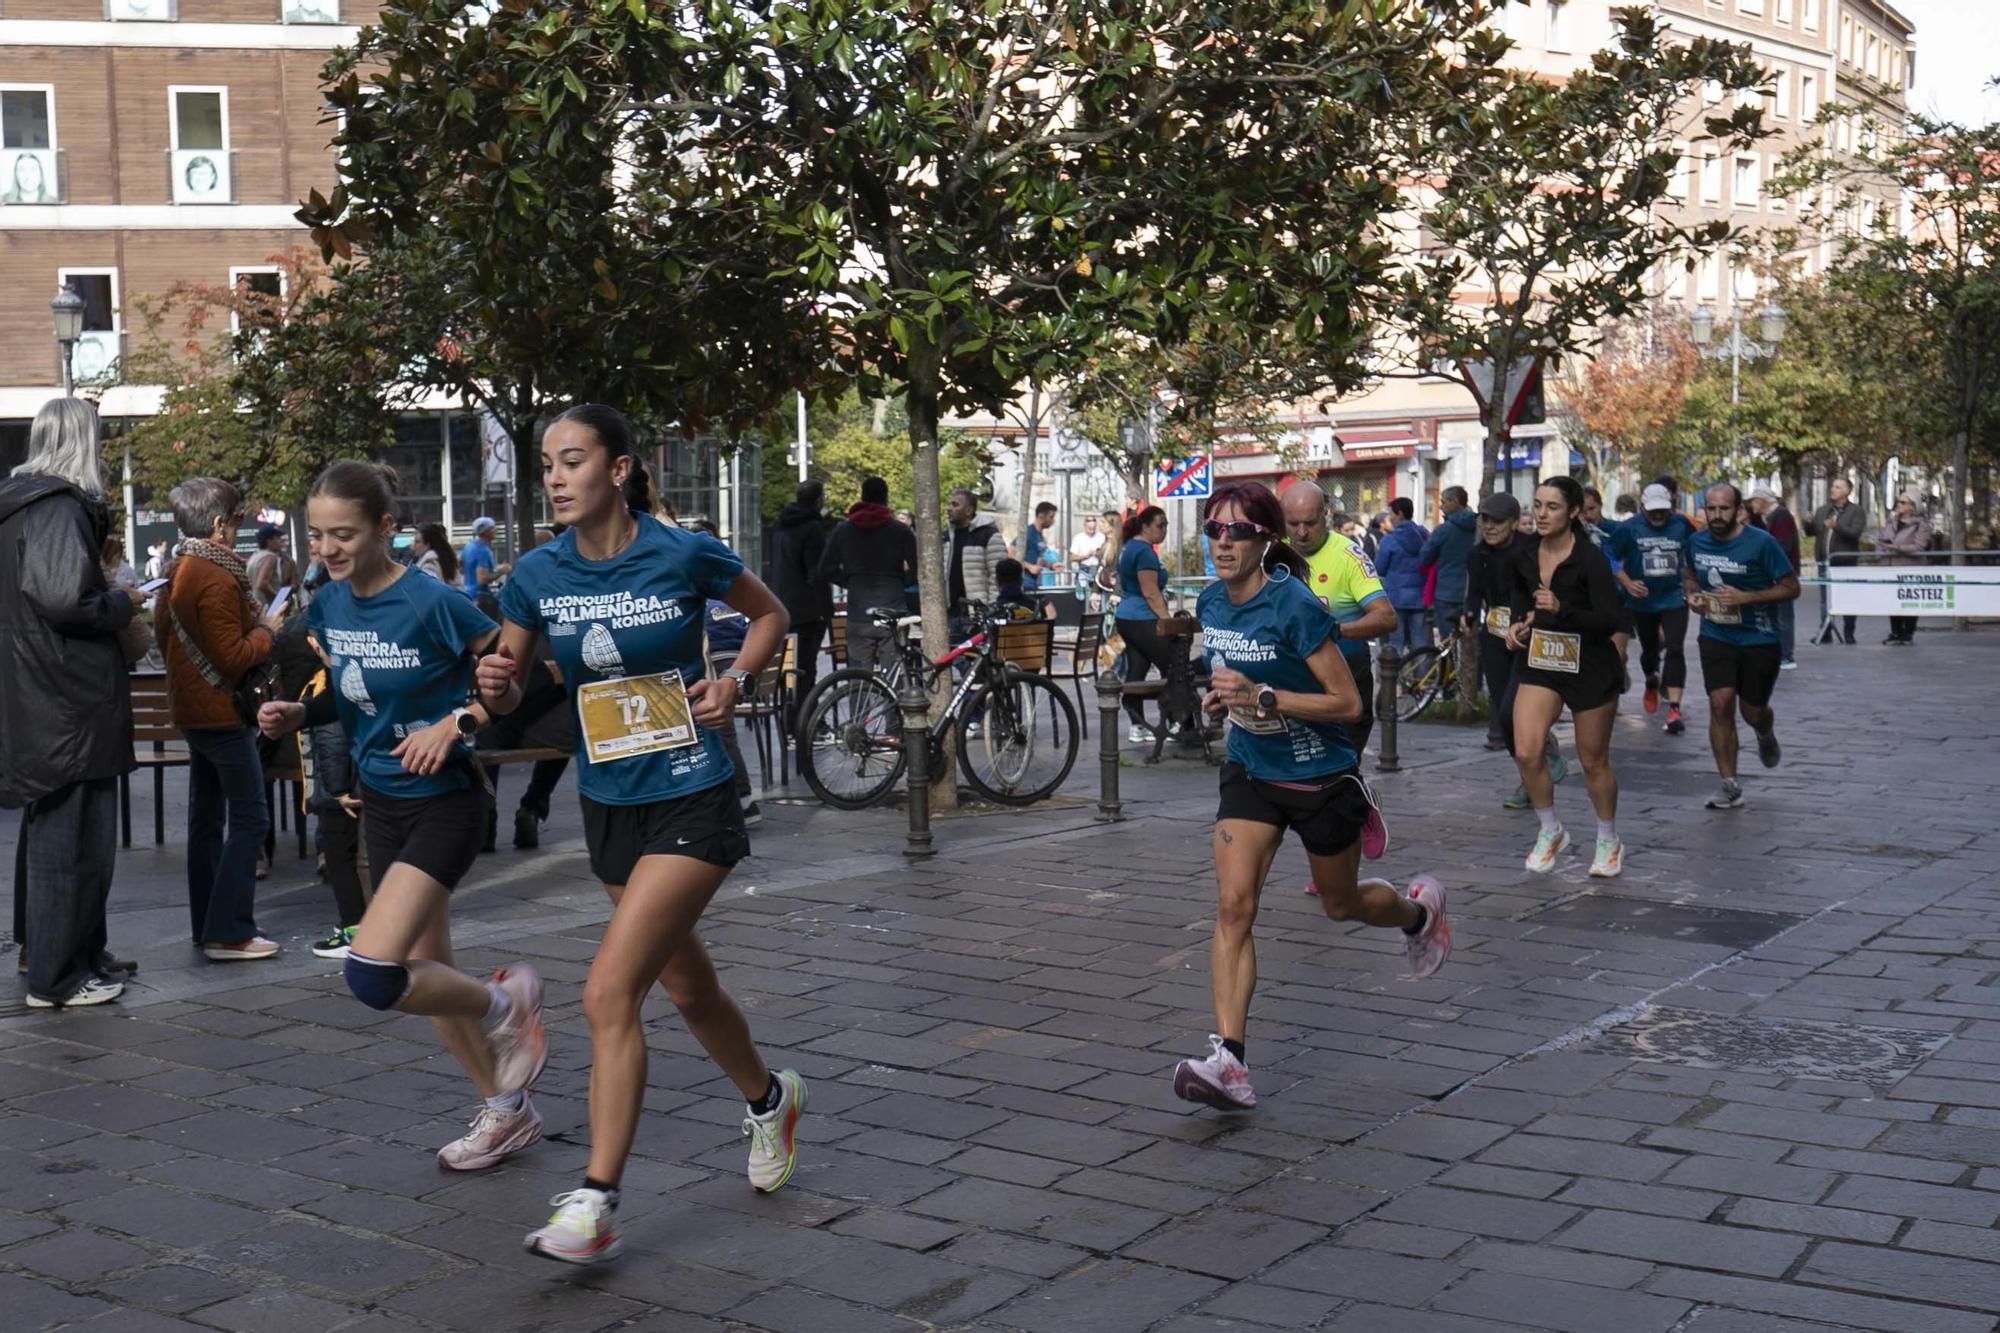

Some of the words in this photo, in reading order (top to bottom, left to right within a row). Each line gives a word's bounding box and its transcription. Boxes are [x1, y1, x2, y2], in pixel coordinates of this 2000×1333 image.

[555, 591, 633, 608] CONQUISTA
[1897, 588, 1944, 601] GASTEIZ
[557, 595, 663, 623] ALMENDRA
[611, 606, 684, 629] KONKISTA
[1226, 650, 1278, 662] KONKISTA
[1542, 640, 1565, 657] 370
[362, 656, 422, 669] KONKISTA
[616, 694, 650, 725] 72
